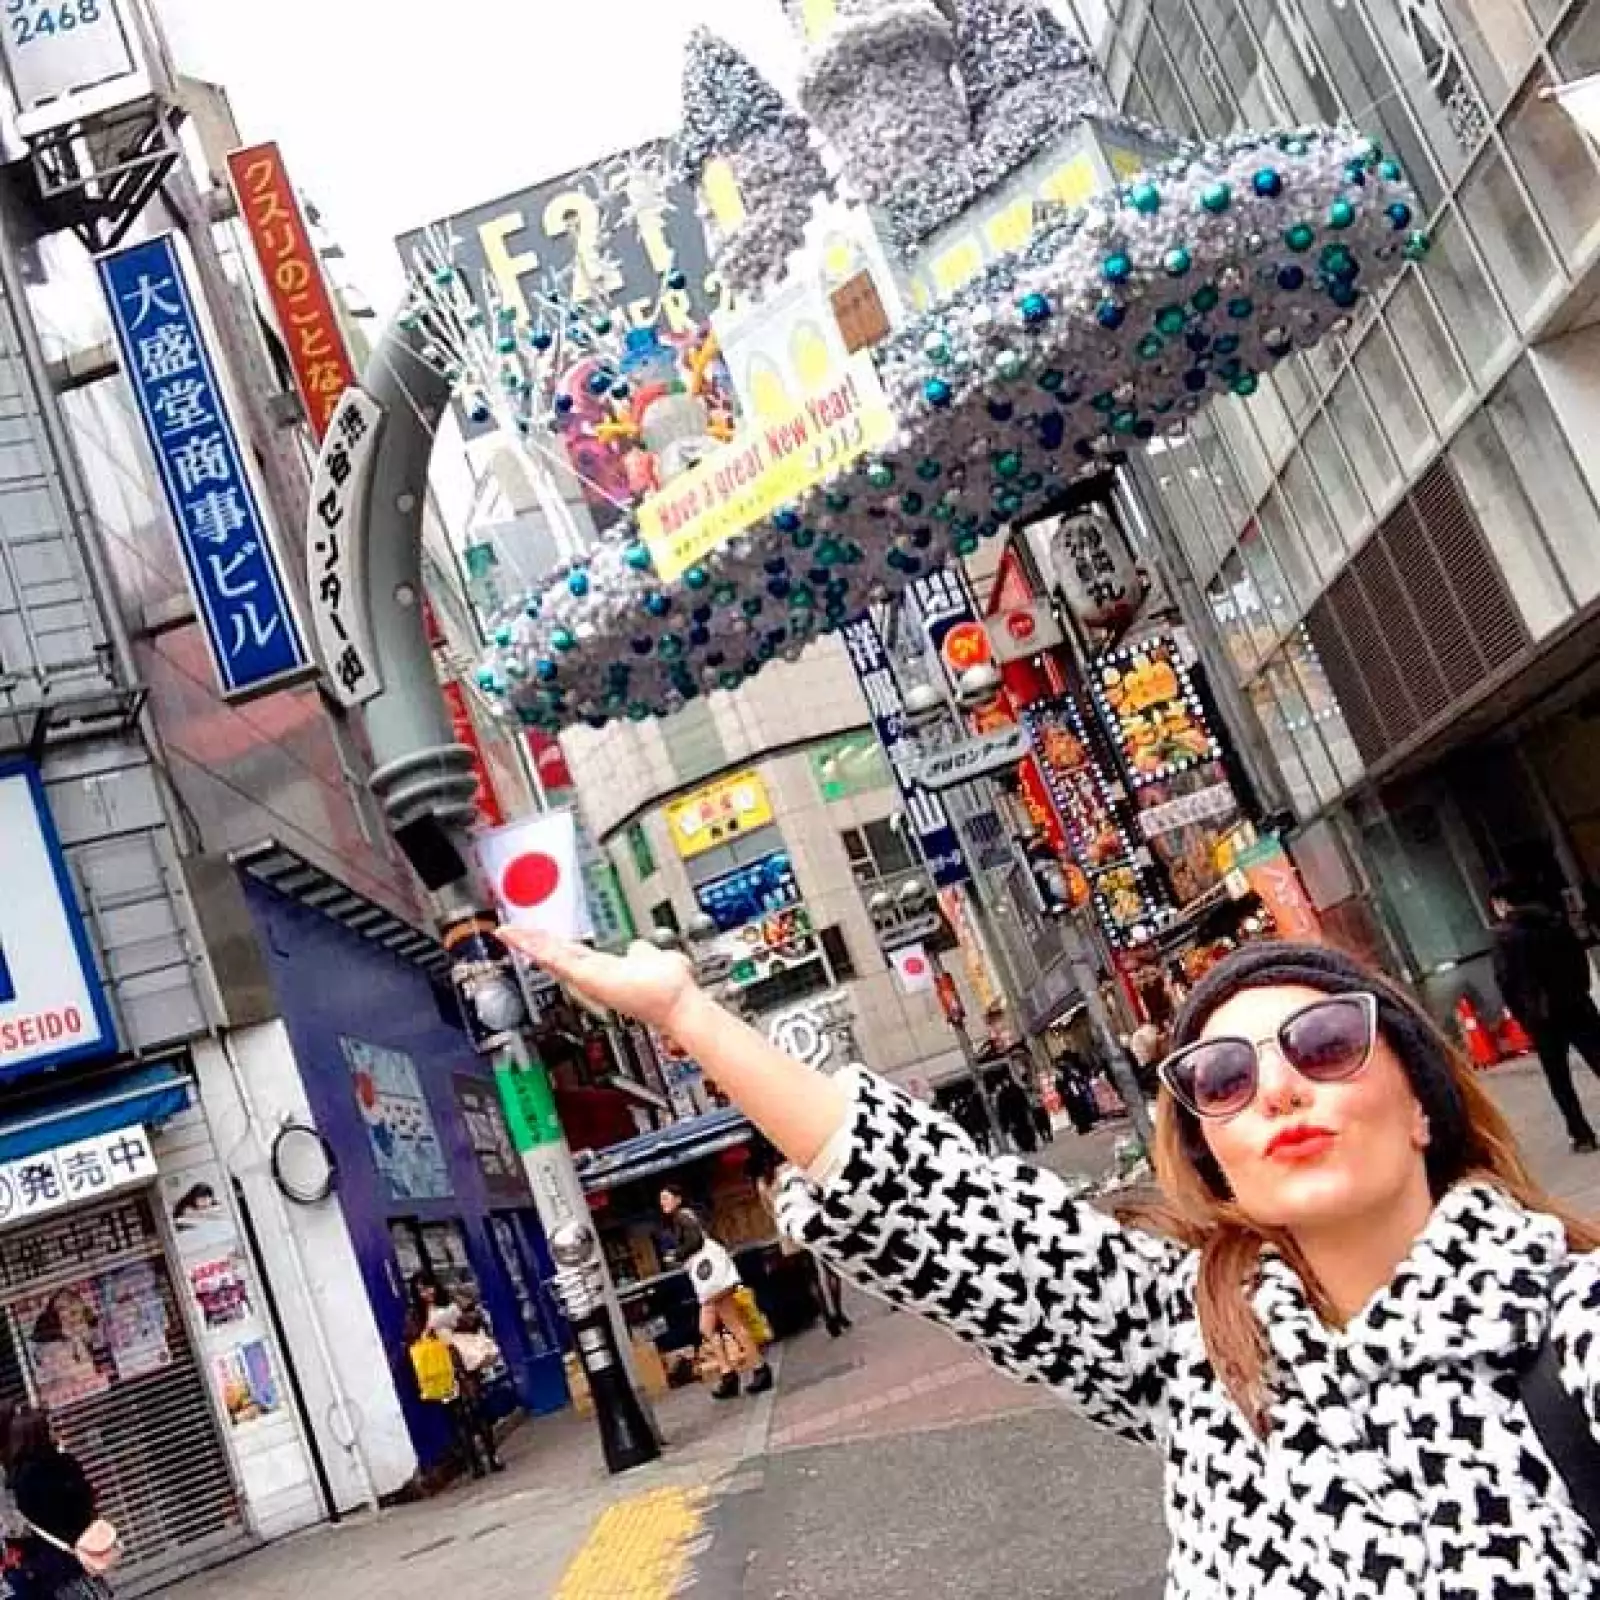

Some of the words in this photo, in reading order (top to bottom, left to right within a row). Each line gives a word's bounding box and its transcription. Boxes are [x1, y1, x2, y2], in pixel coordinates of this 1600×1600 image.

[11, 0, 100, 46] 2468
[122, 274, 279, 658] 大盛堂商事ビル
[714, 442, 764, 503] great
[763, 412, 808, 457] New
[314, 403, 368, 694] 渋谷センター街
[1, 1007, 81, 1052] SEIDO
